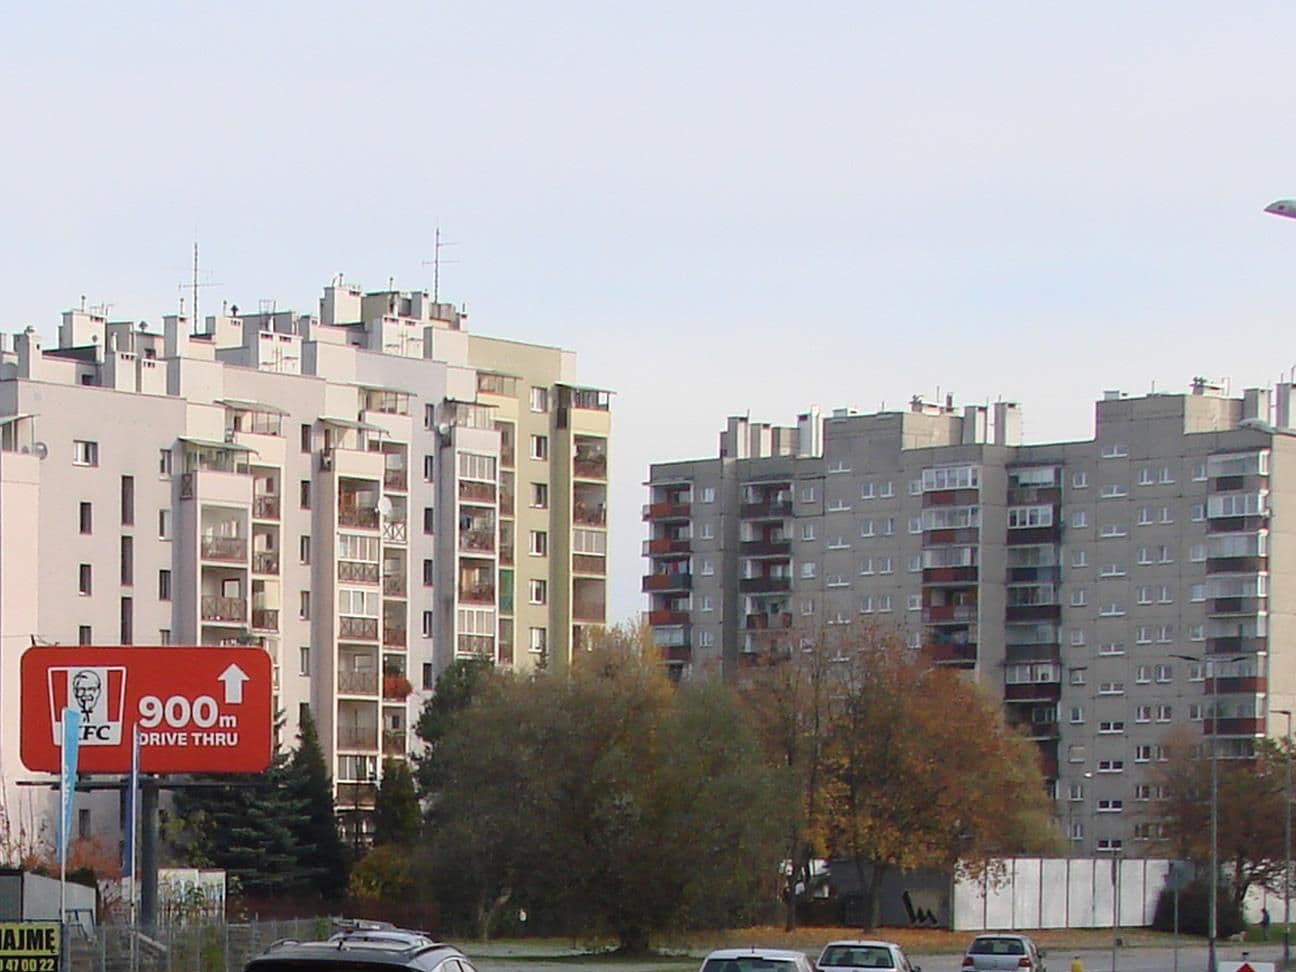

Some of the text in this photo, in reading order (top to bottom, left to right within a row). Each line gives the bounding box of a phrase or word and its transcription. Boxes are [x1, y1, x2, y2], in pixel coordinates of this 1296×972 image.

[78, 724, 111, 741] FC
[192, 732, 238, 746] THRU
[5, 958, 19, 972] 47
[21, 958, 37, 972] 00
[39, 958, 55, 972] 22
